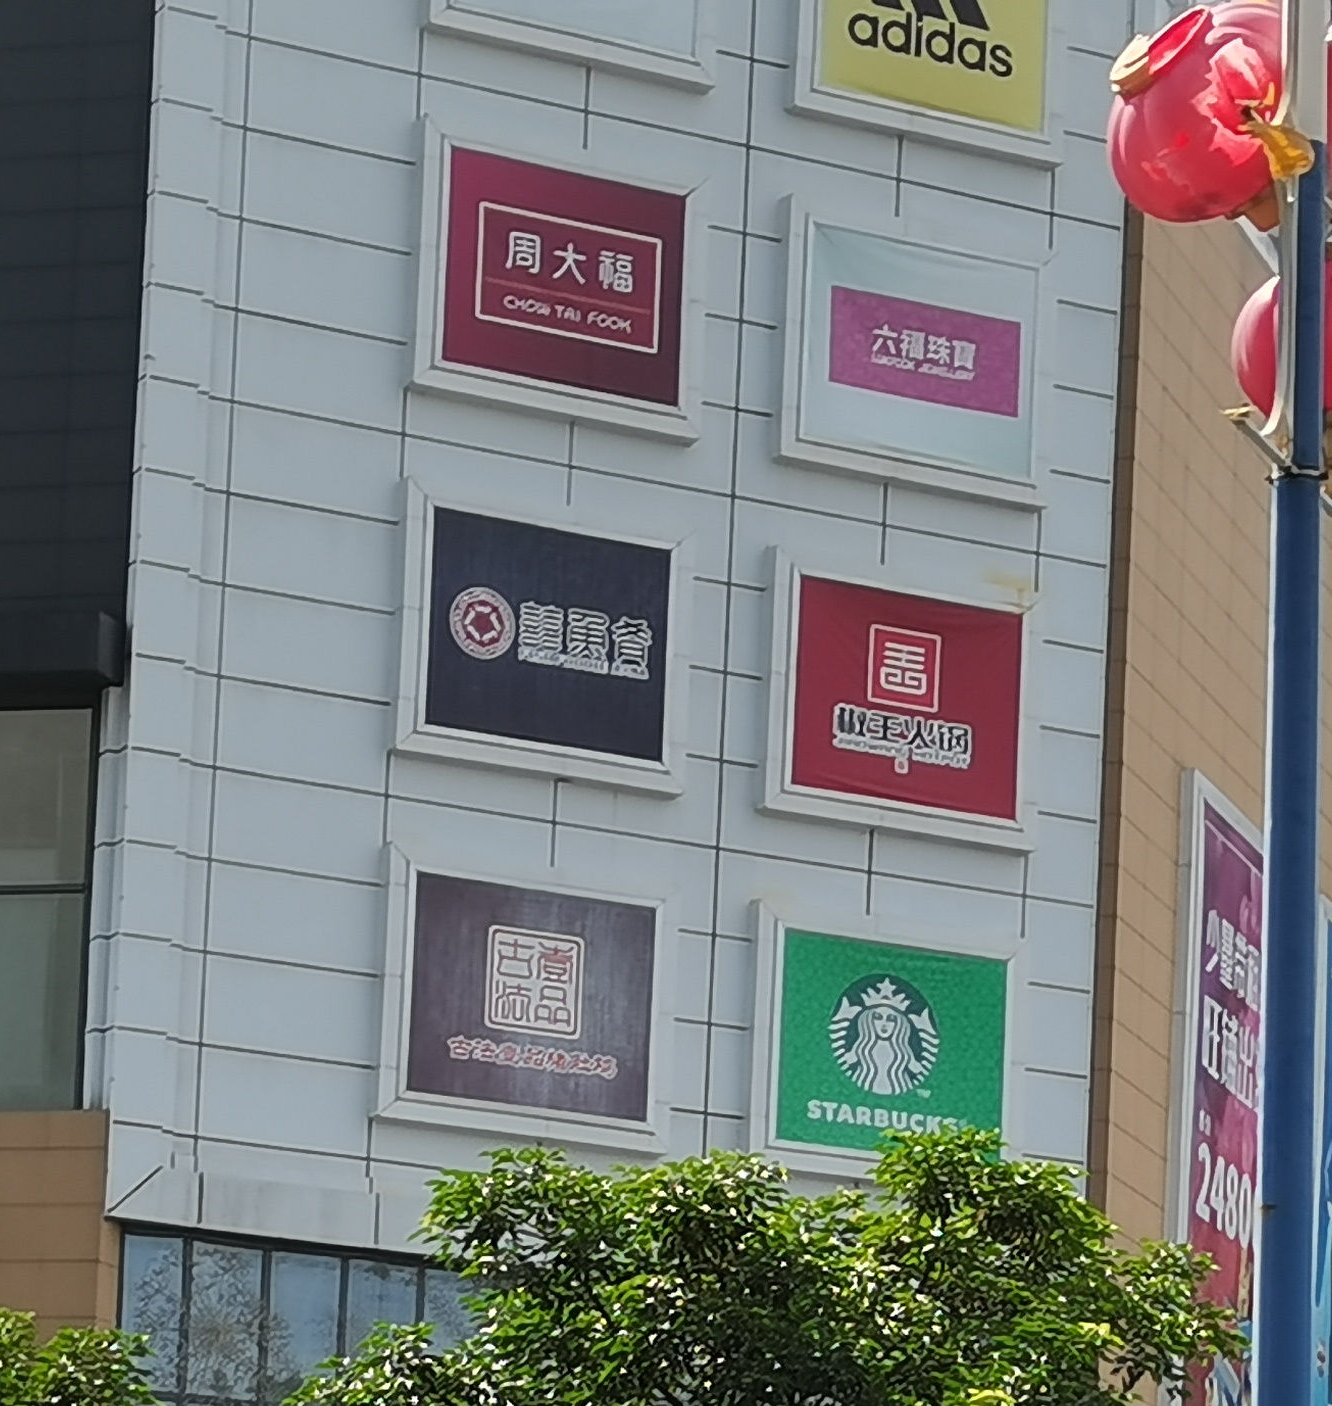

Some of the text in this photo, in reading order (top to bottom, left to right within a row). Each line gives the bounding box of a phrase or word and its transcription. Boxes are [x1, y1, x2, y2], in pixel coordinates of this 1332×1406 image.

[847, 12, 1014, 78] adidas
[505, 231, 634, 293] 周大福
[554, 304, 582, 323] TAI
[587, 311, 632, 334] FOOK
[1195, 1142, 1252, 1250] 2480
